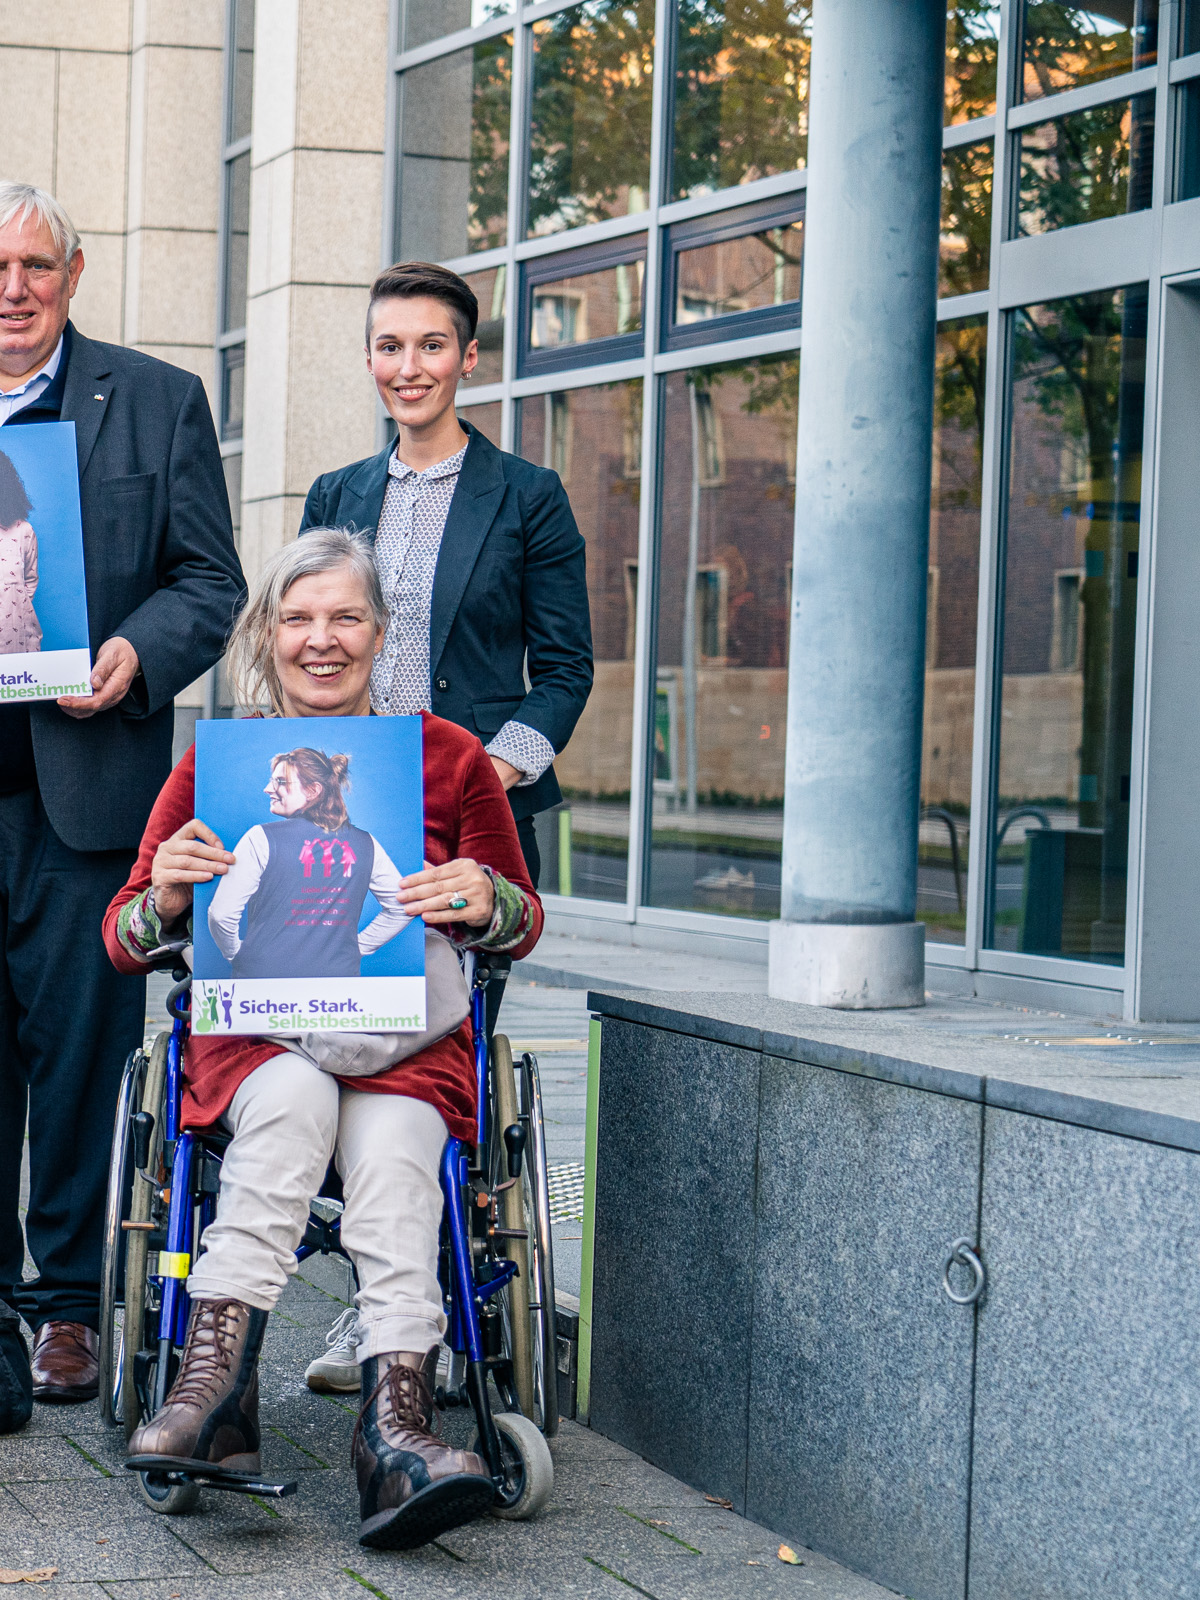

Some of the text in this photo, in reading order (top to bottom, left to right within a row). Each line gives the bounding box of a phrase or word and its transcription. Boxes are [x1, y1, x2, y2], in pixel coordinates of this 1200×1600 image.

[239, 998, 364, 1014] Sicher. Stark.
[268, 1013, 425, 1029] Selbstbestimmt.
